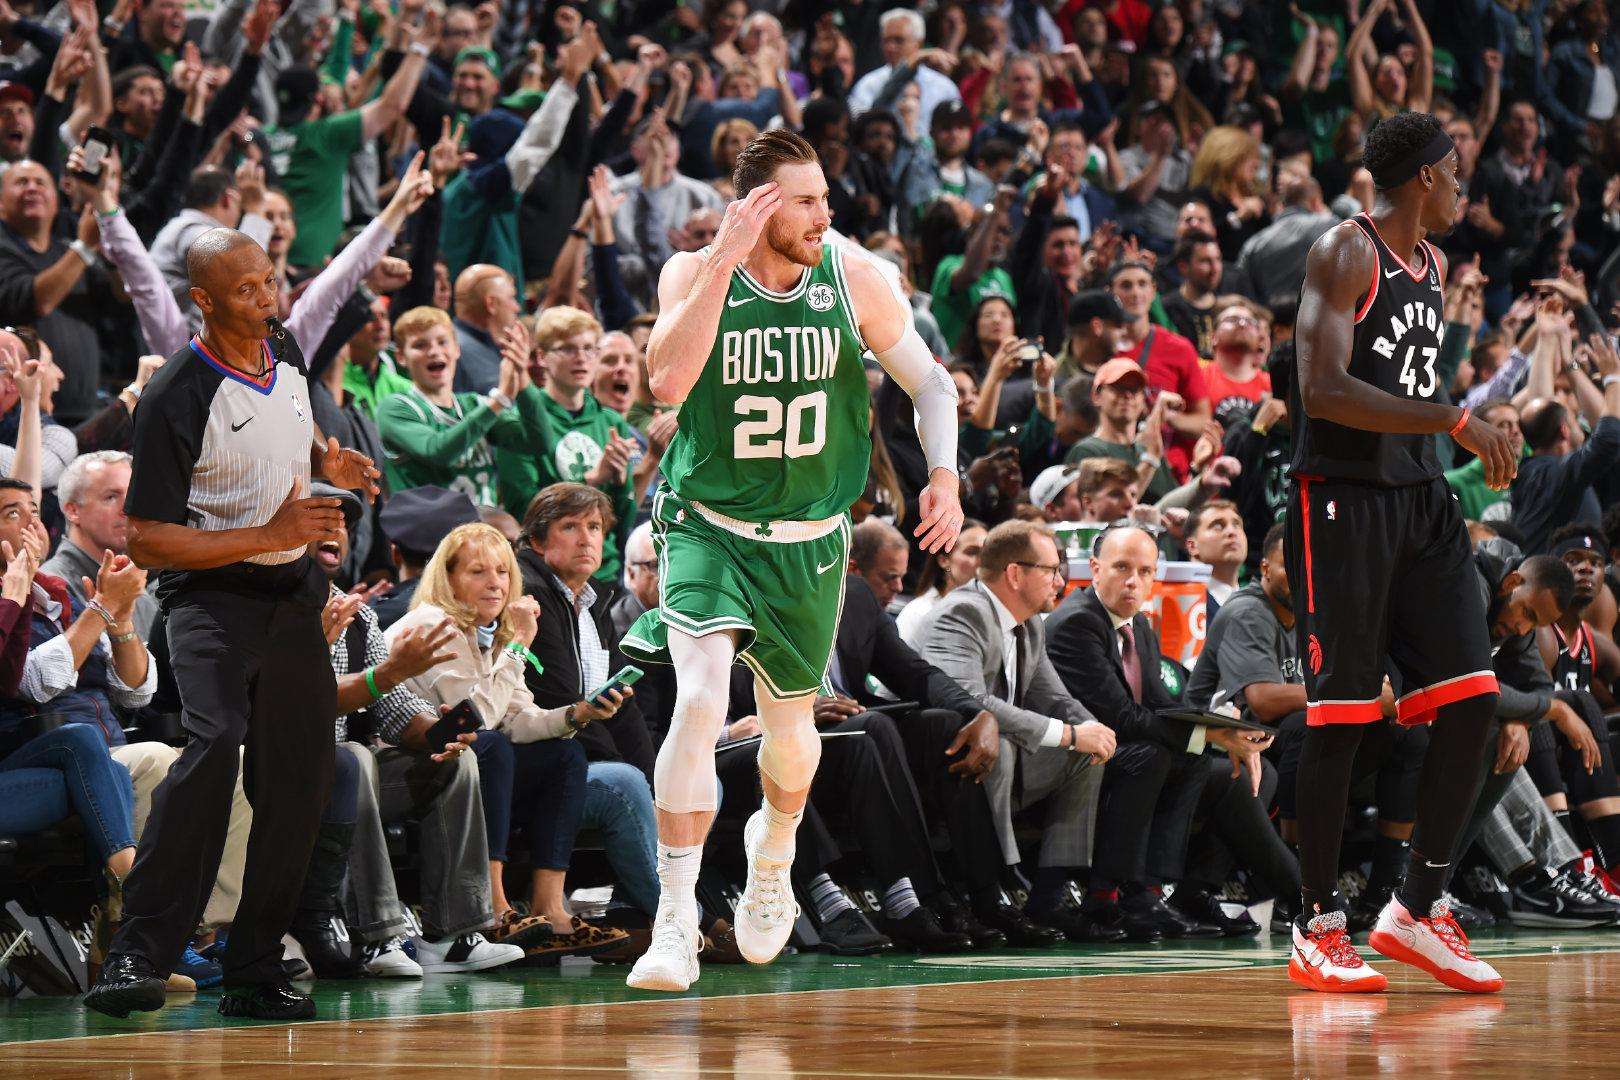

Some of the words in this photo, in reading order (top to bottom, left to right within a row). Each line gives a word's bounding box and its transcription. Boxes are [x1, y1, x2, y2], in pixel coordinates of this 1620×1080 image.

[722, 327, 840, 385] BOSTON
[1399, 345, 1437, 397] 43
[733, 390, 828, 459] 20
